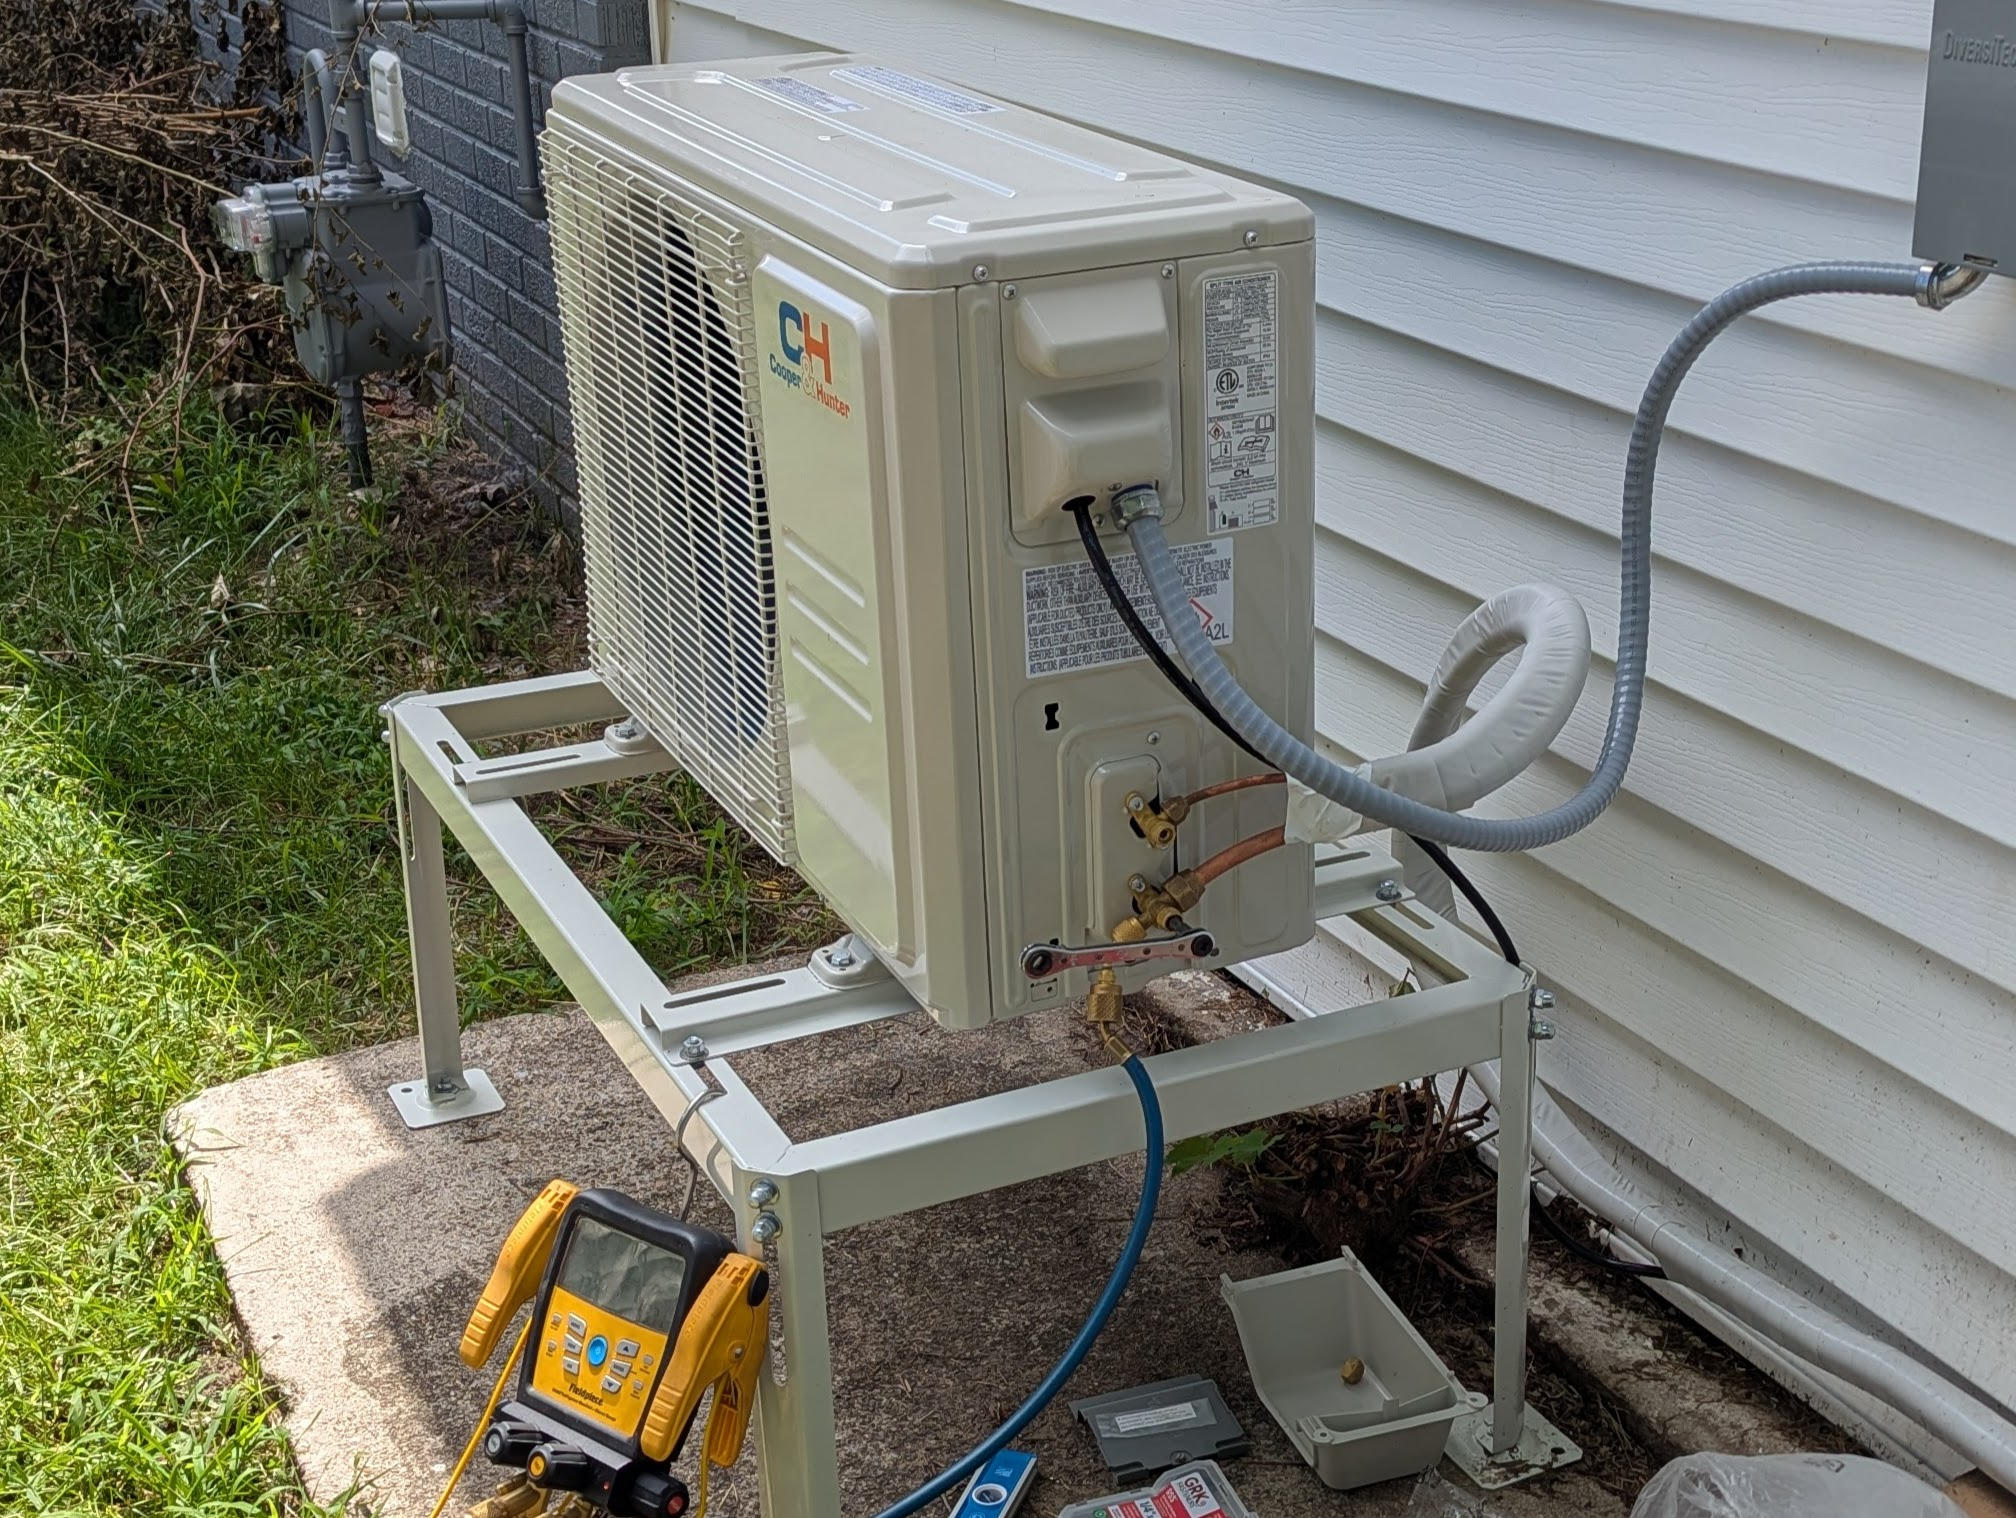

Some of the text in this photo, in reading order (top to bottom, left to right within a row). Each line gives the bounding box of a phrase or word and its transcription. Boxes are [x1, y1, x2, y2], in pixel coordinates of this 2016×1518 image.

[769, 353, 802, 389] Cooper
[815, 381, 851, 419] Hunter
[1206, 623, 1229, 640] A2L
[569, 1383, 604, 1406] Fieldpiece
[1184, 1477, 1209, 1505] GRK
